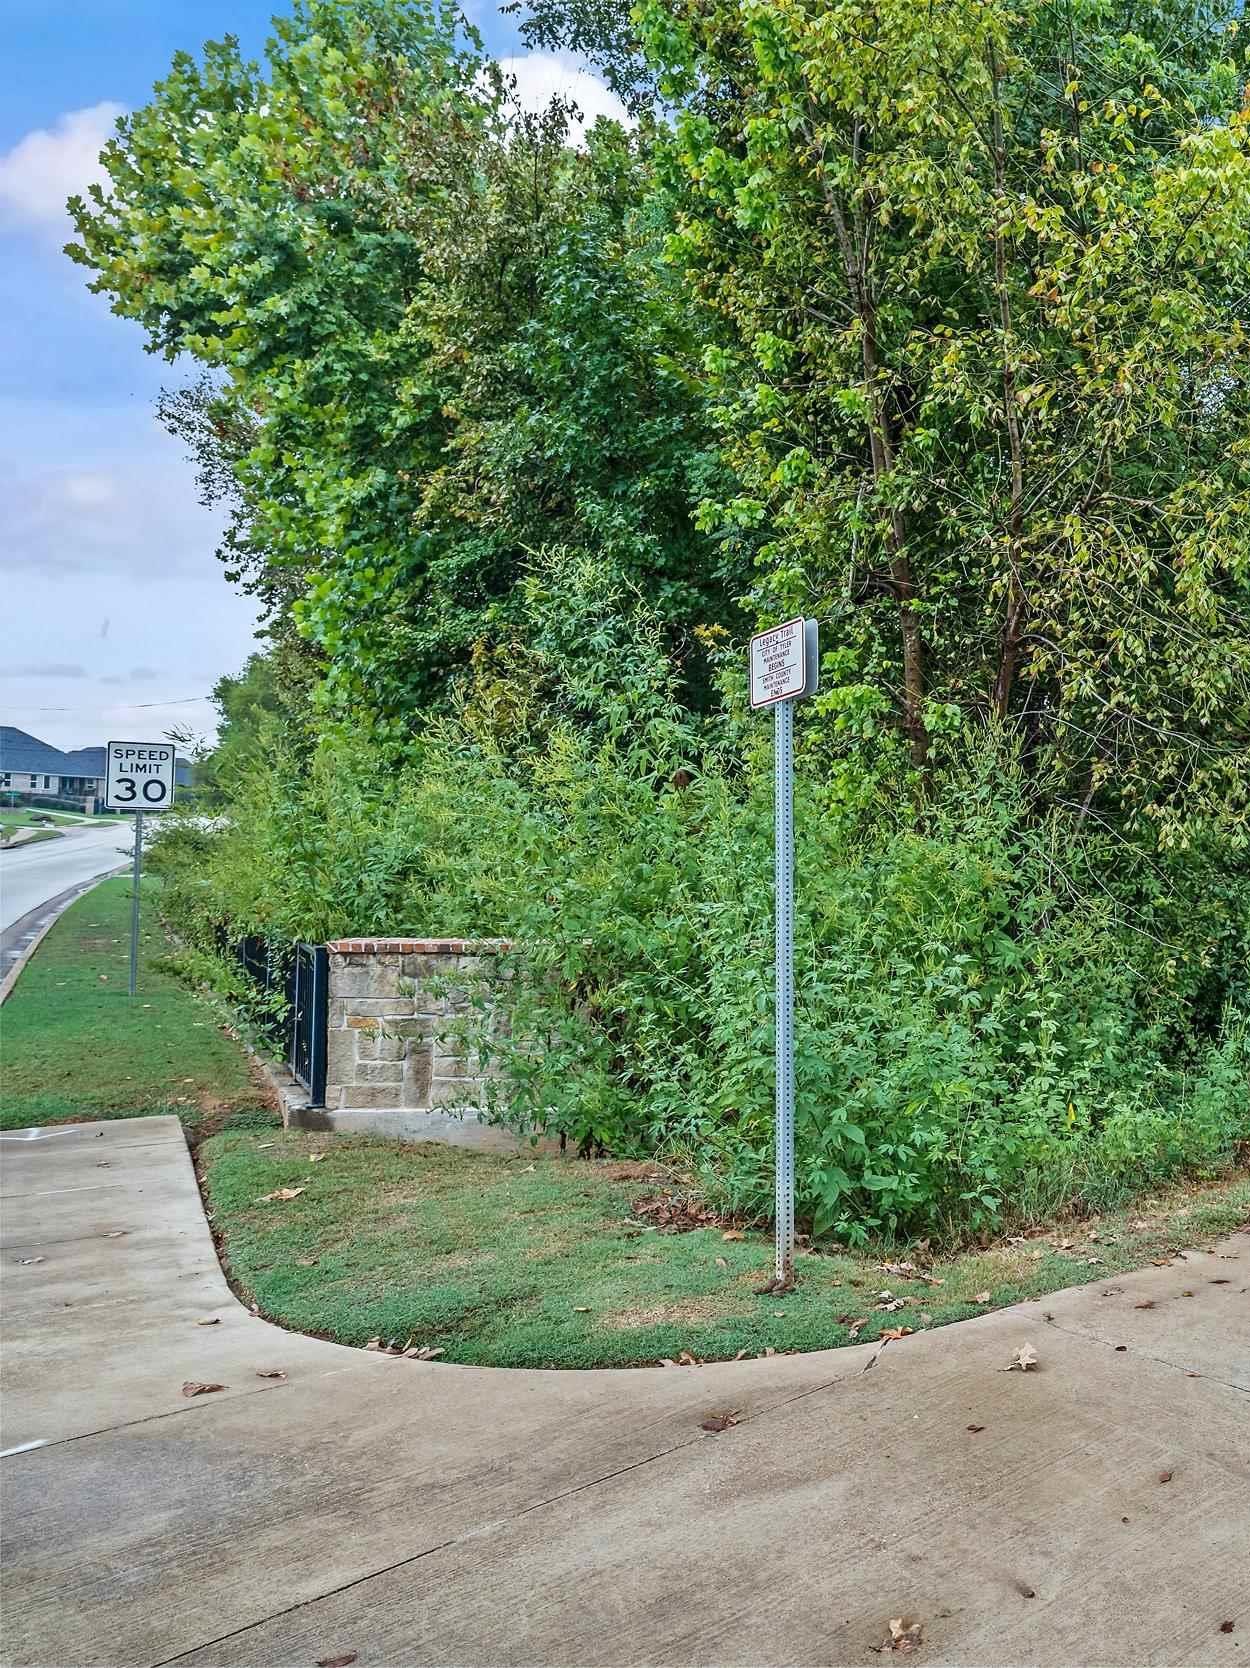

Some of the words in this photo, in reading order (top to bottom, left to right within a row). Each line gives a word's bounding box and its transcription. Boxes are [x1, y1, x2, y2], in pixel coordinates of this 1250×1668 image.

[760, 634, 779, 647] Legacy
[780, 626, 794, 638] Trail
[763, 649, 790, 664] MAINTENANCE
[768, 659, 785, 672] BEGINS
[113, 749, 169, 760] SPEED
[120, 763, 163, 774] LIMIT
[113, 778, 167, 802] 30
